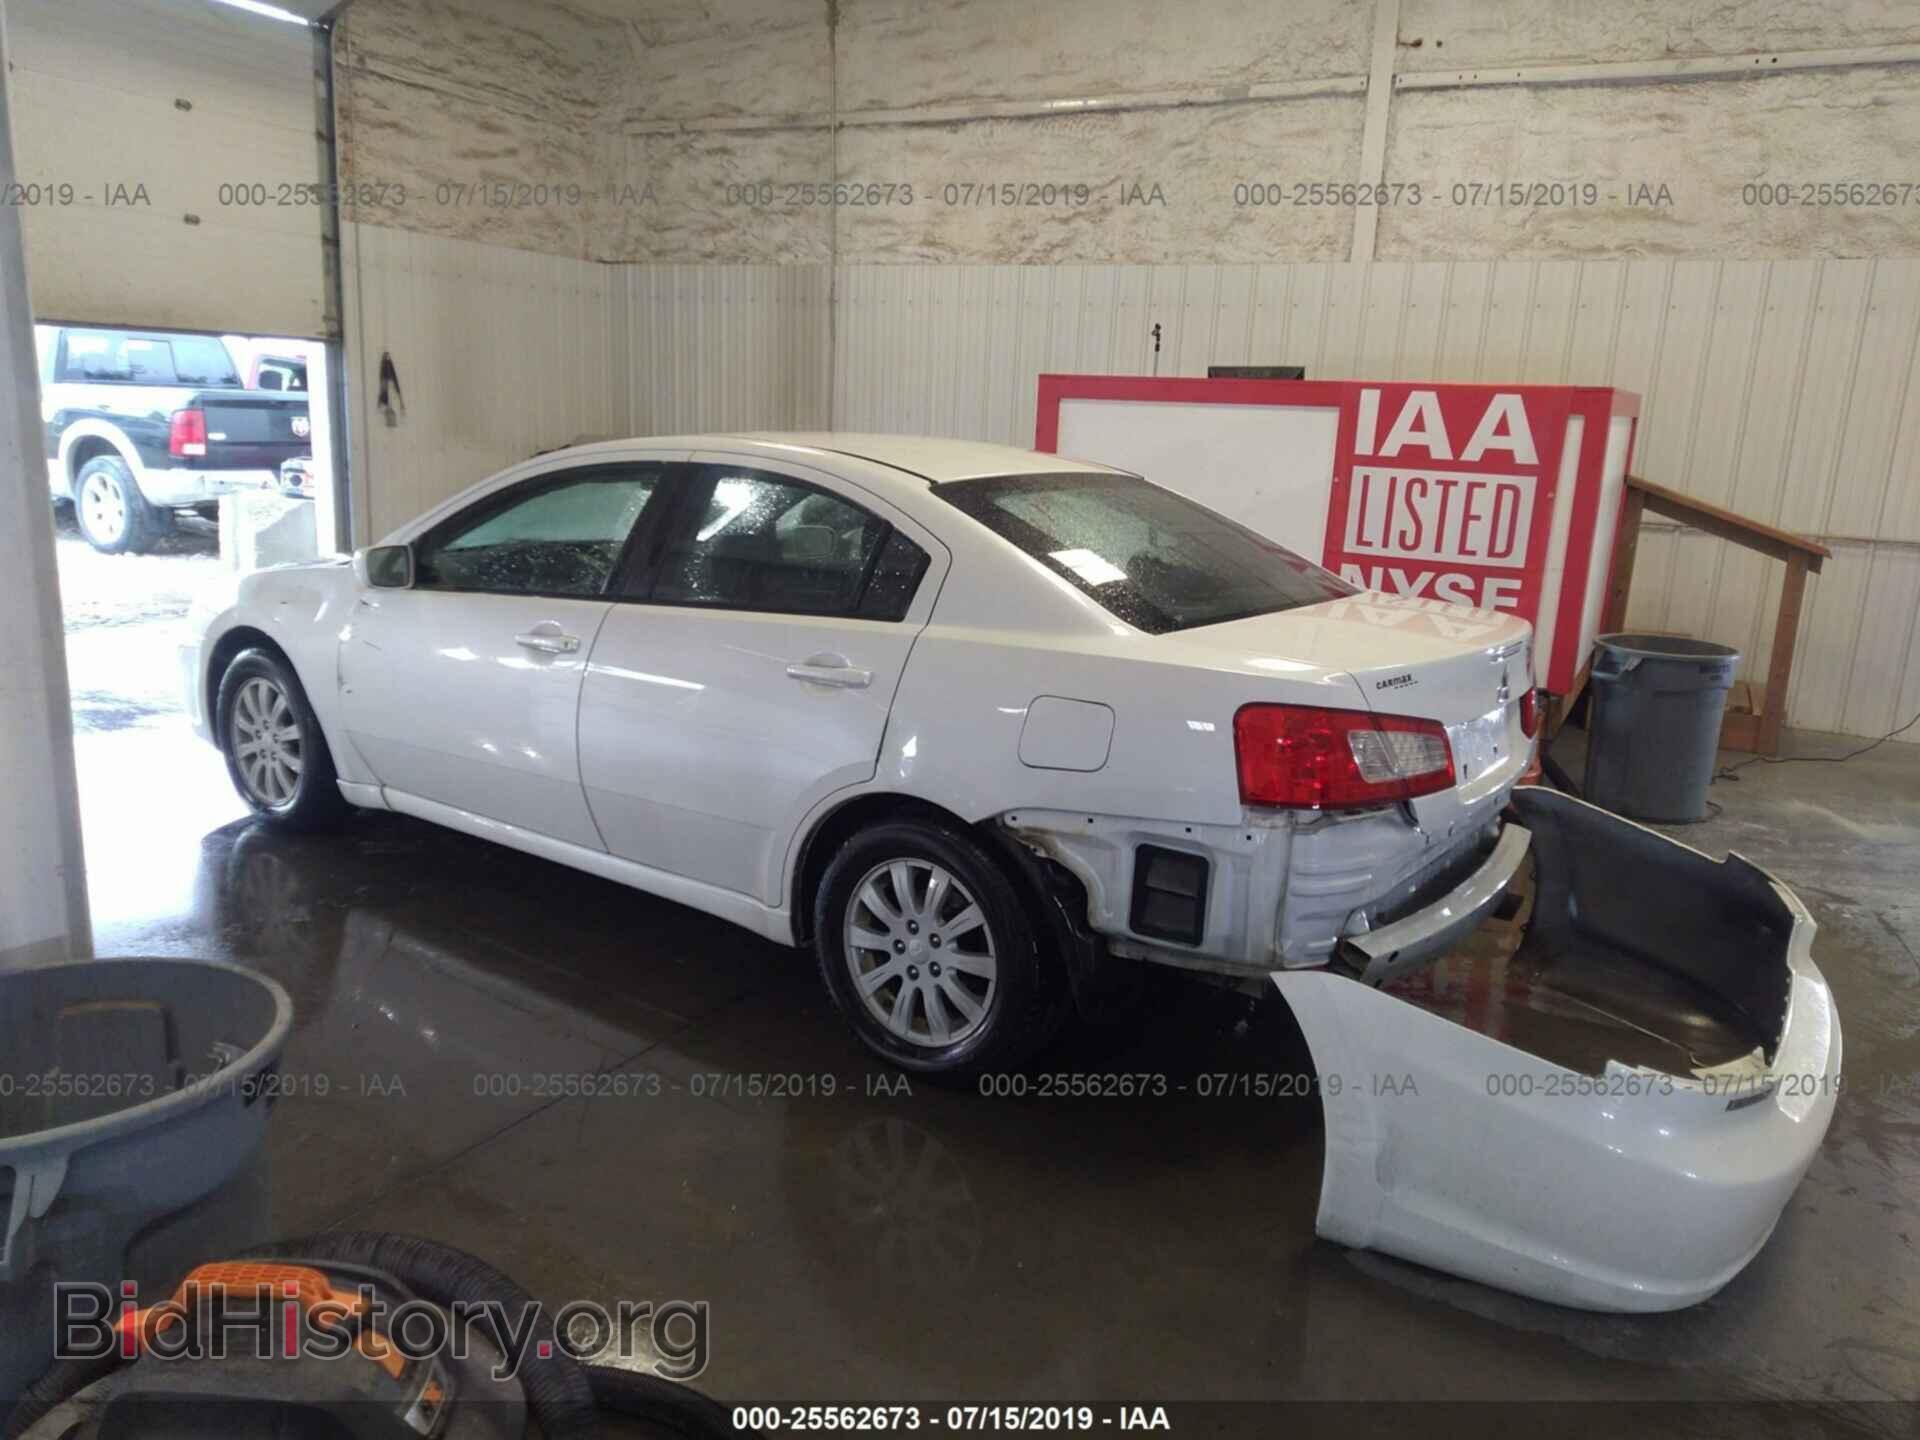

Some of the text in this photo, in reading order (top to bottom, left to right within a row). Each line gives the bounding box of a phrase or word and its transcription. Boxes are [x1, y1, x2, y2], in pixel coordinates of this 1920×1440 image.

[1354, 388, 1540, 465] IAA
[1355, 474, 1522, 559] LISTED
[1339, 563, 1523, 610] NYSE
